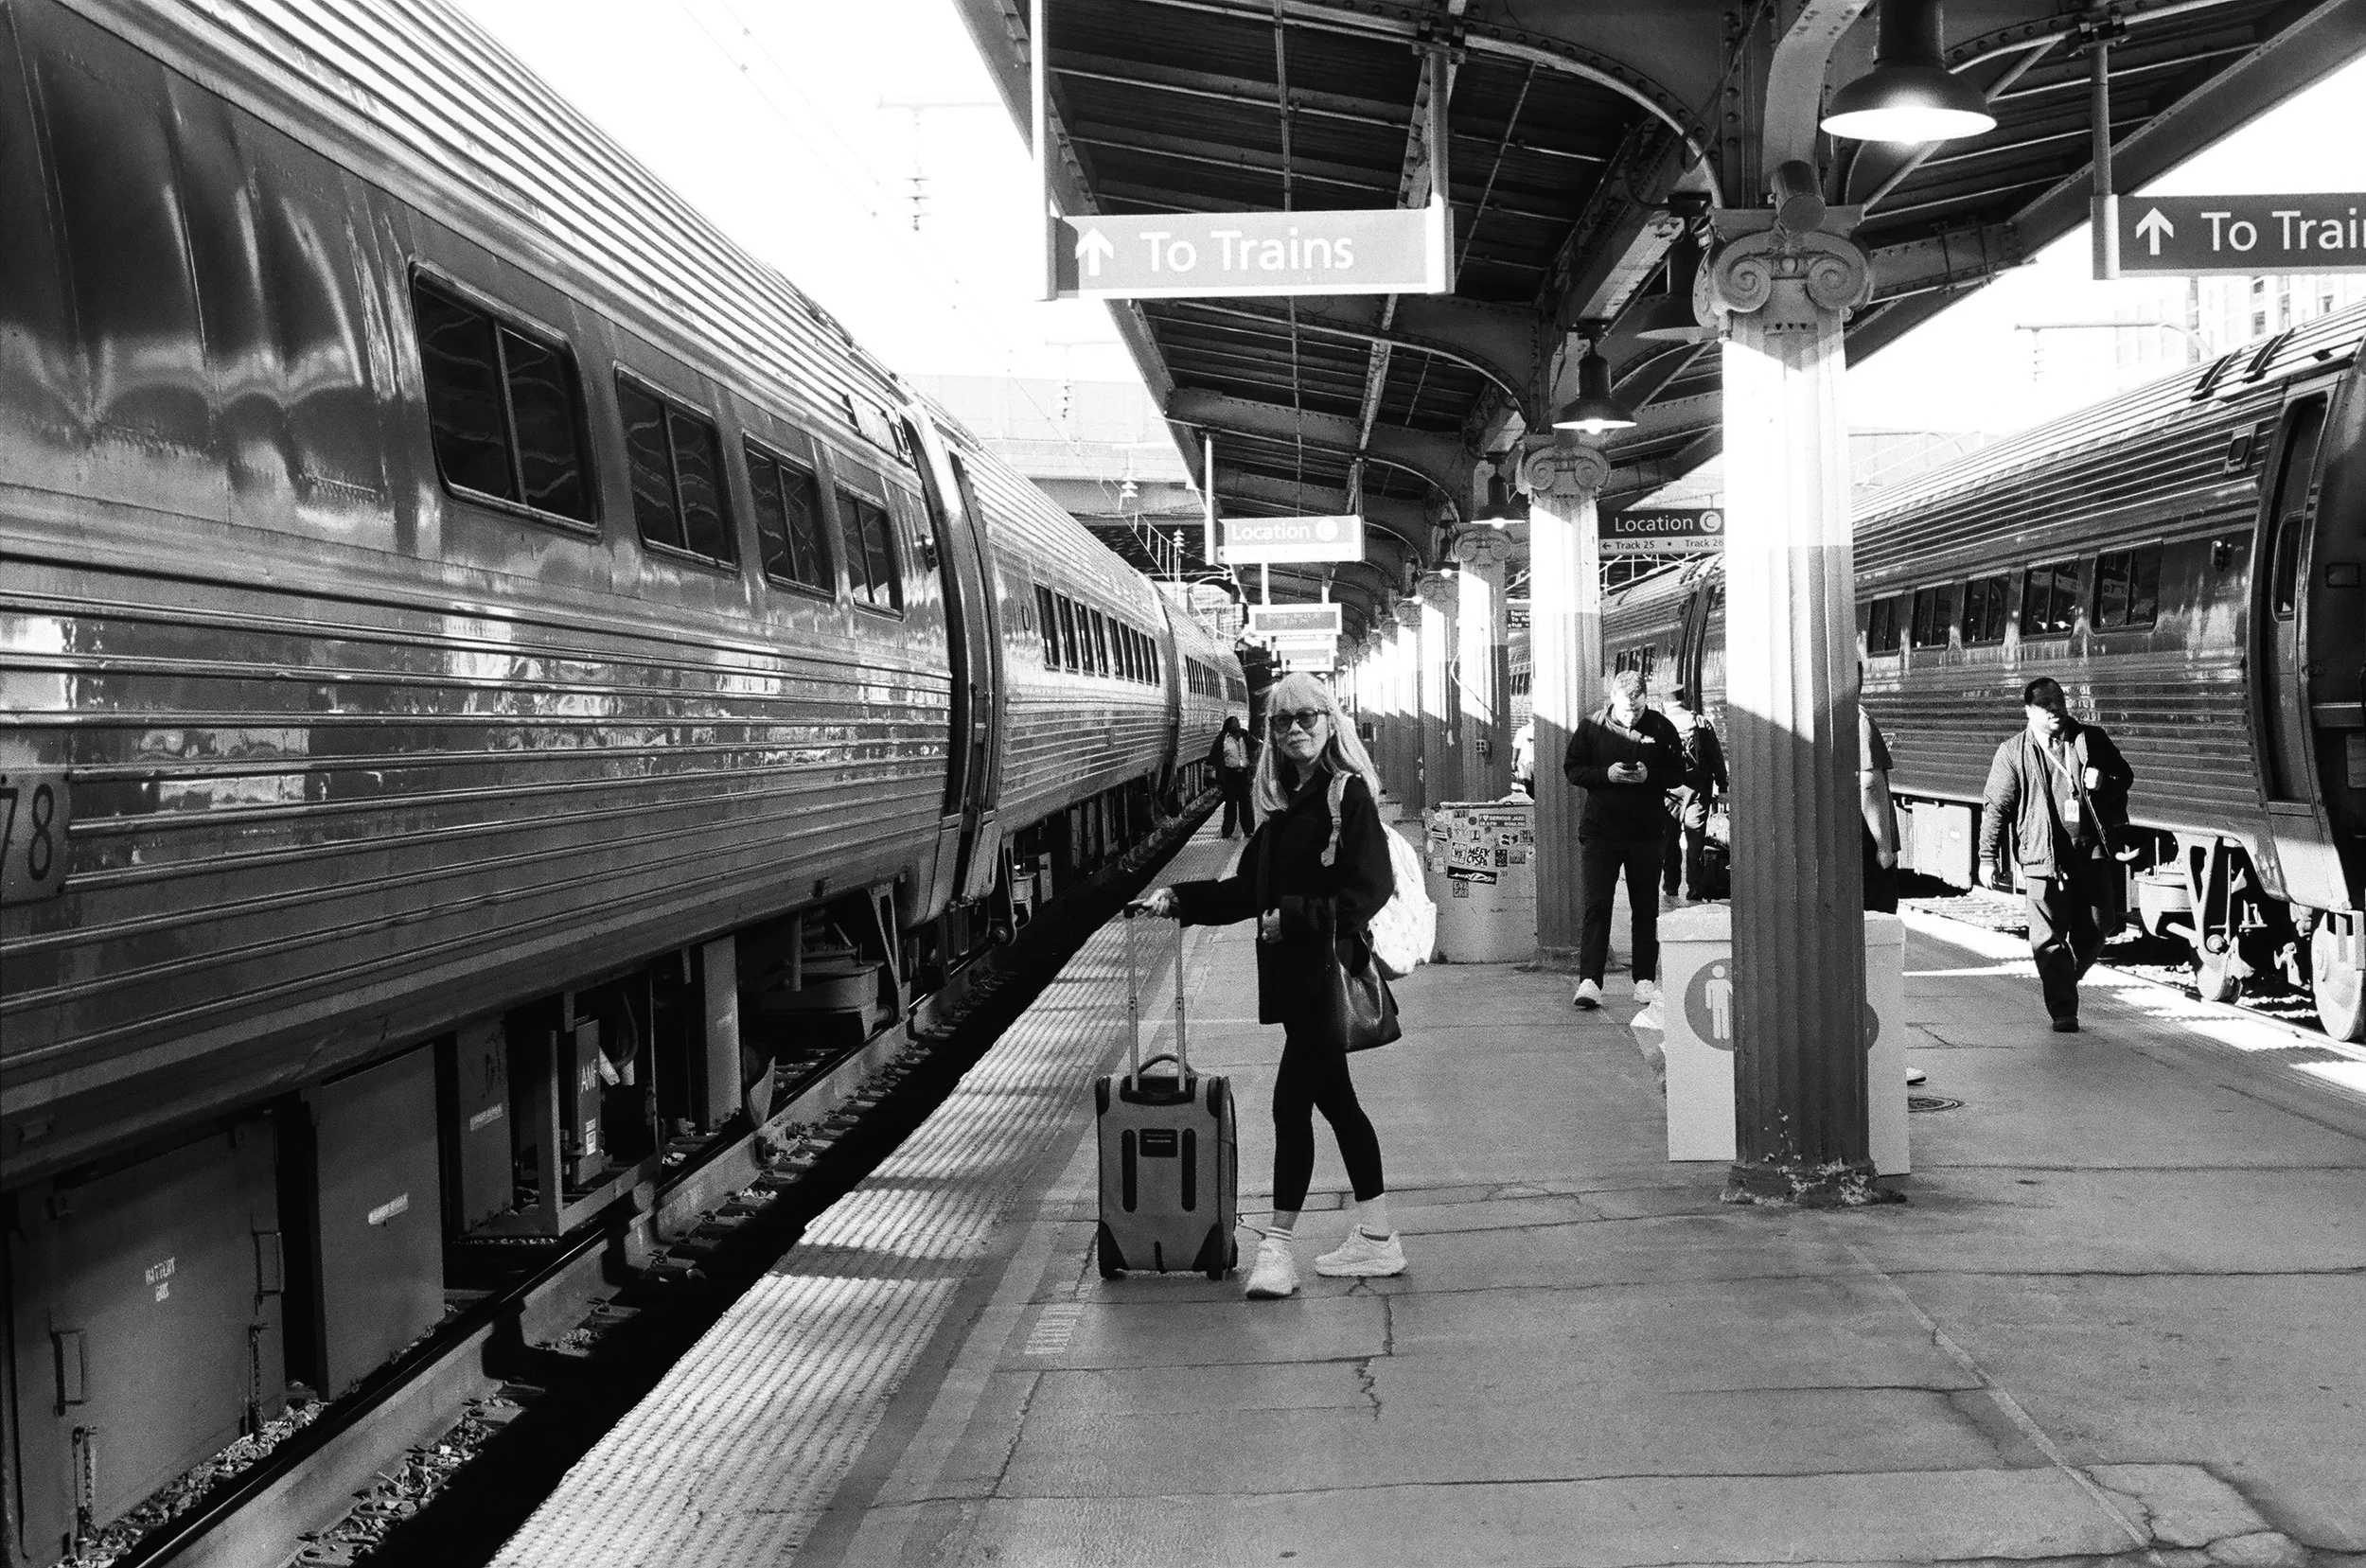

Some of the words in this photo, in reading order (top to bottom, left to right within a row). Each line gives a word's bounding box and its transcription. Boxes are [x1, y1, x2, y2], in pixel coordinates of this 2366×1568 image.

[2200, 211, 2257, 252] To
[2271, 207, 2366, 251] Trai
[1139, 231, 1197, 273] To
[1210, 227, 1354, 272] Trains
[1231, 521, 1311, 540] Location
[1615, 515, 1694, 533] Location
[1615, 540, 1641, 550] Track
[1643, 540, 1655, 549] 25
[1685, 538, 1710, 548] Track
[1711, 538, 1724, 547] 26
